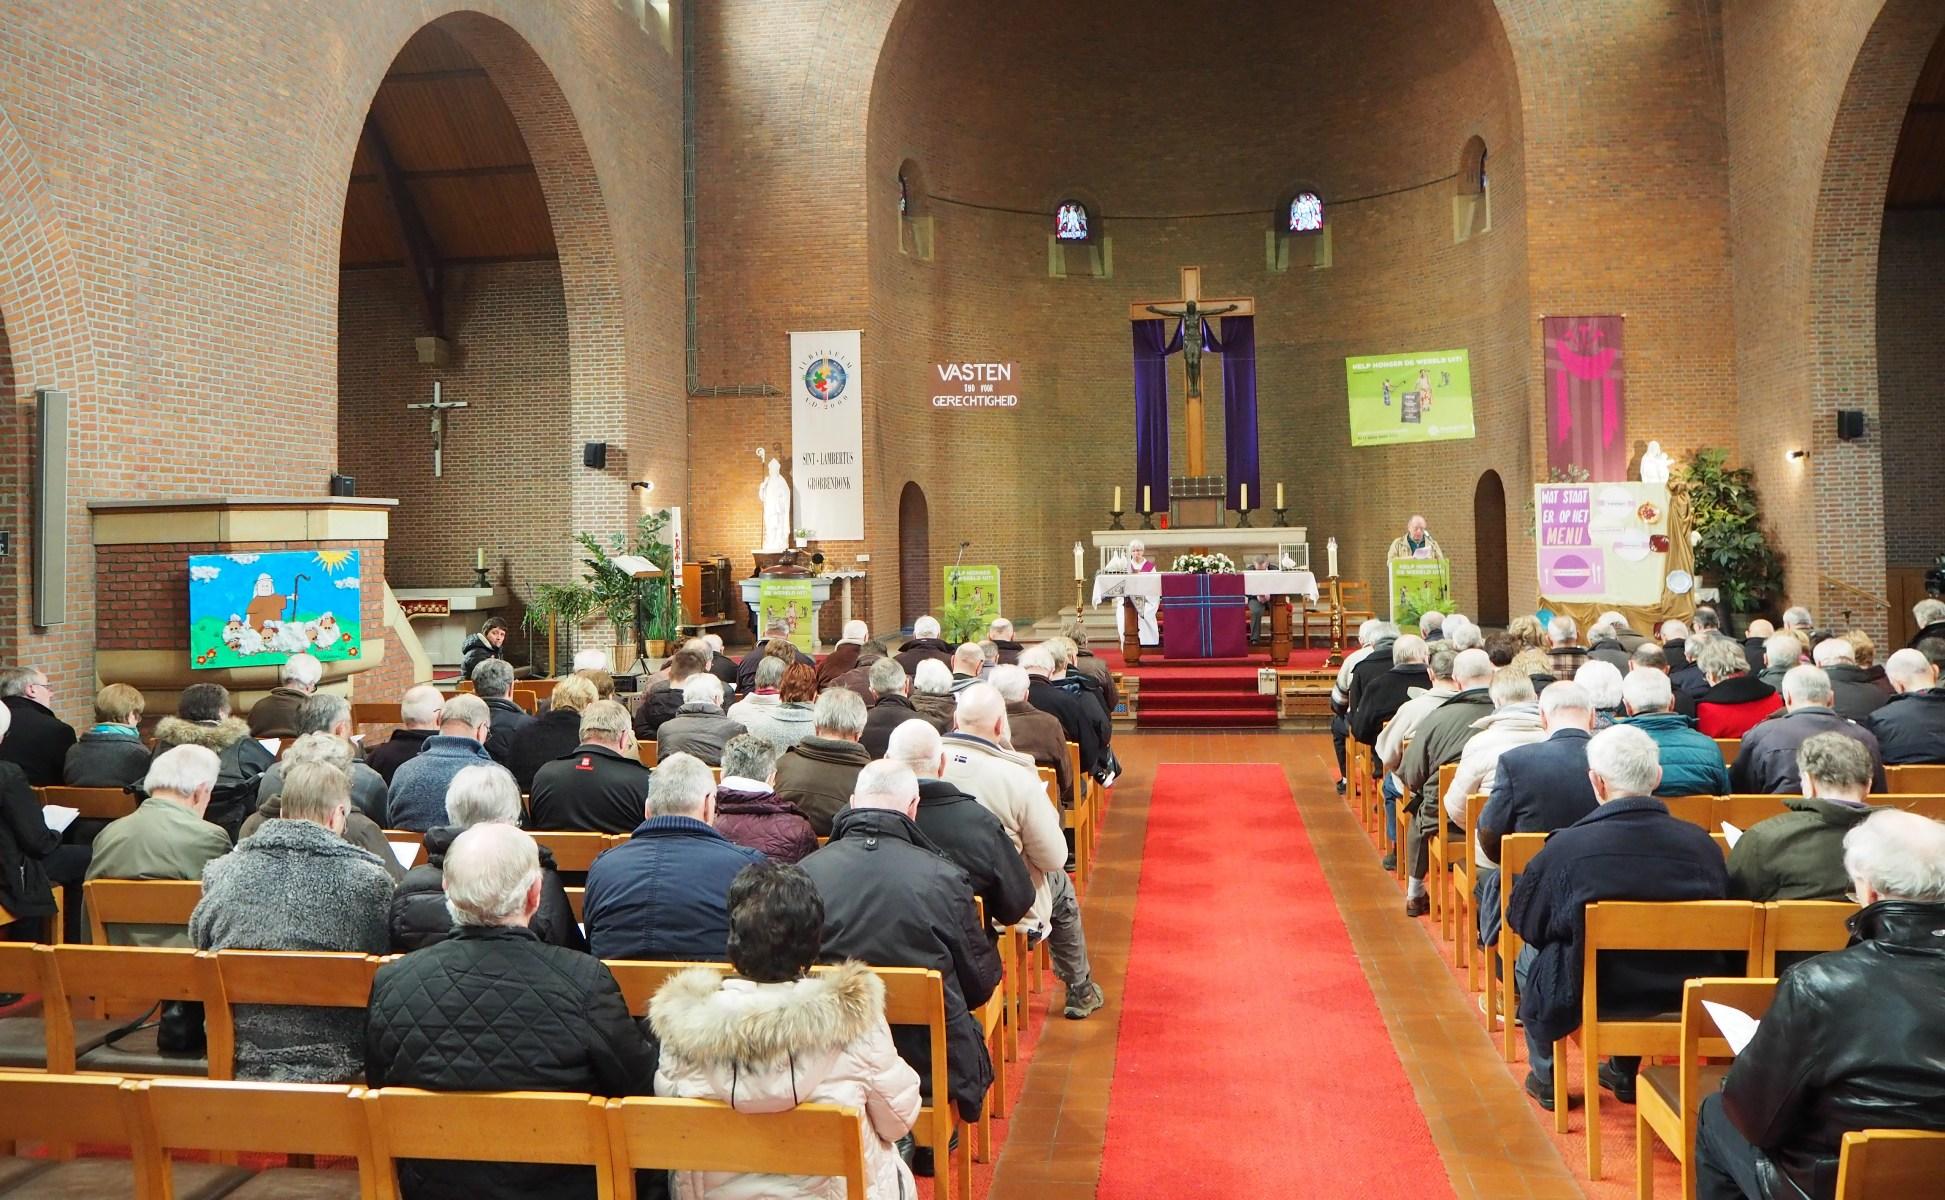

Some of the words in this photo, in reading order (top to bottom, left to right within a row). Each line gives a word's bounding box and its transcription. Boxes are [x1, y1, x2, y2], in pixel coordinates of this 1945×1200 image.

[937, 363, 1011, 381] VASTEN
[980, 383, 994, 393] VOOR
[932, 395, 1018, 407] GERECHTIGHEID
[807, 476, 852, 490] GROBBENDONK
[1542, 490, 1559, 504] WAT
[1562, 490, 1588, 504] STAAT
[1543, 509, 1555, 524] ER
[1559, 509, 1571, 524] OP
[1571, 509, 1589, 524] HET
[1546, 527, 1584, 545] MENU
